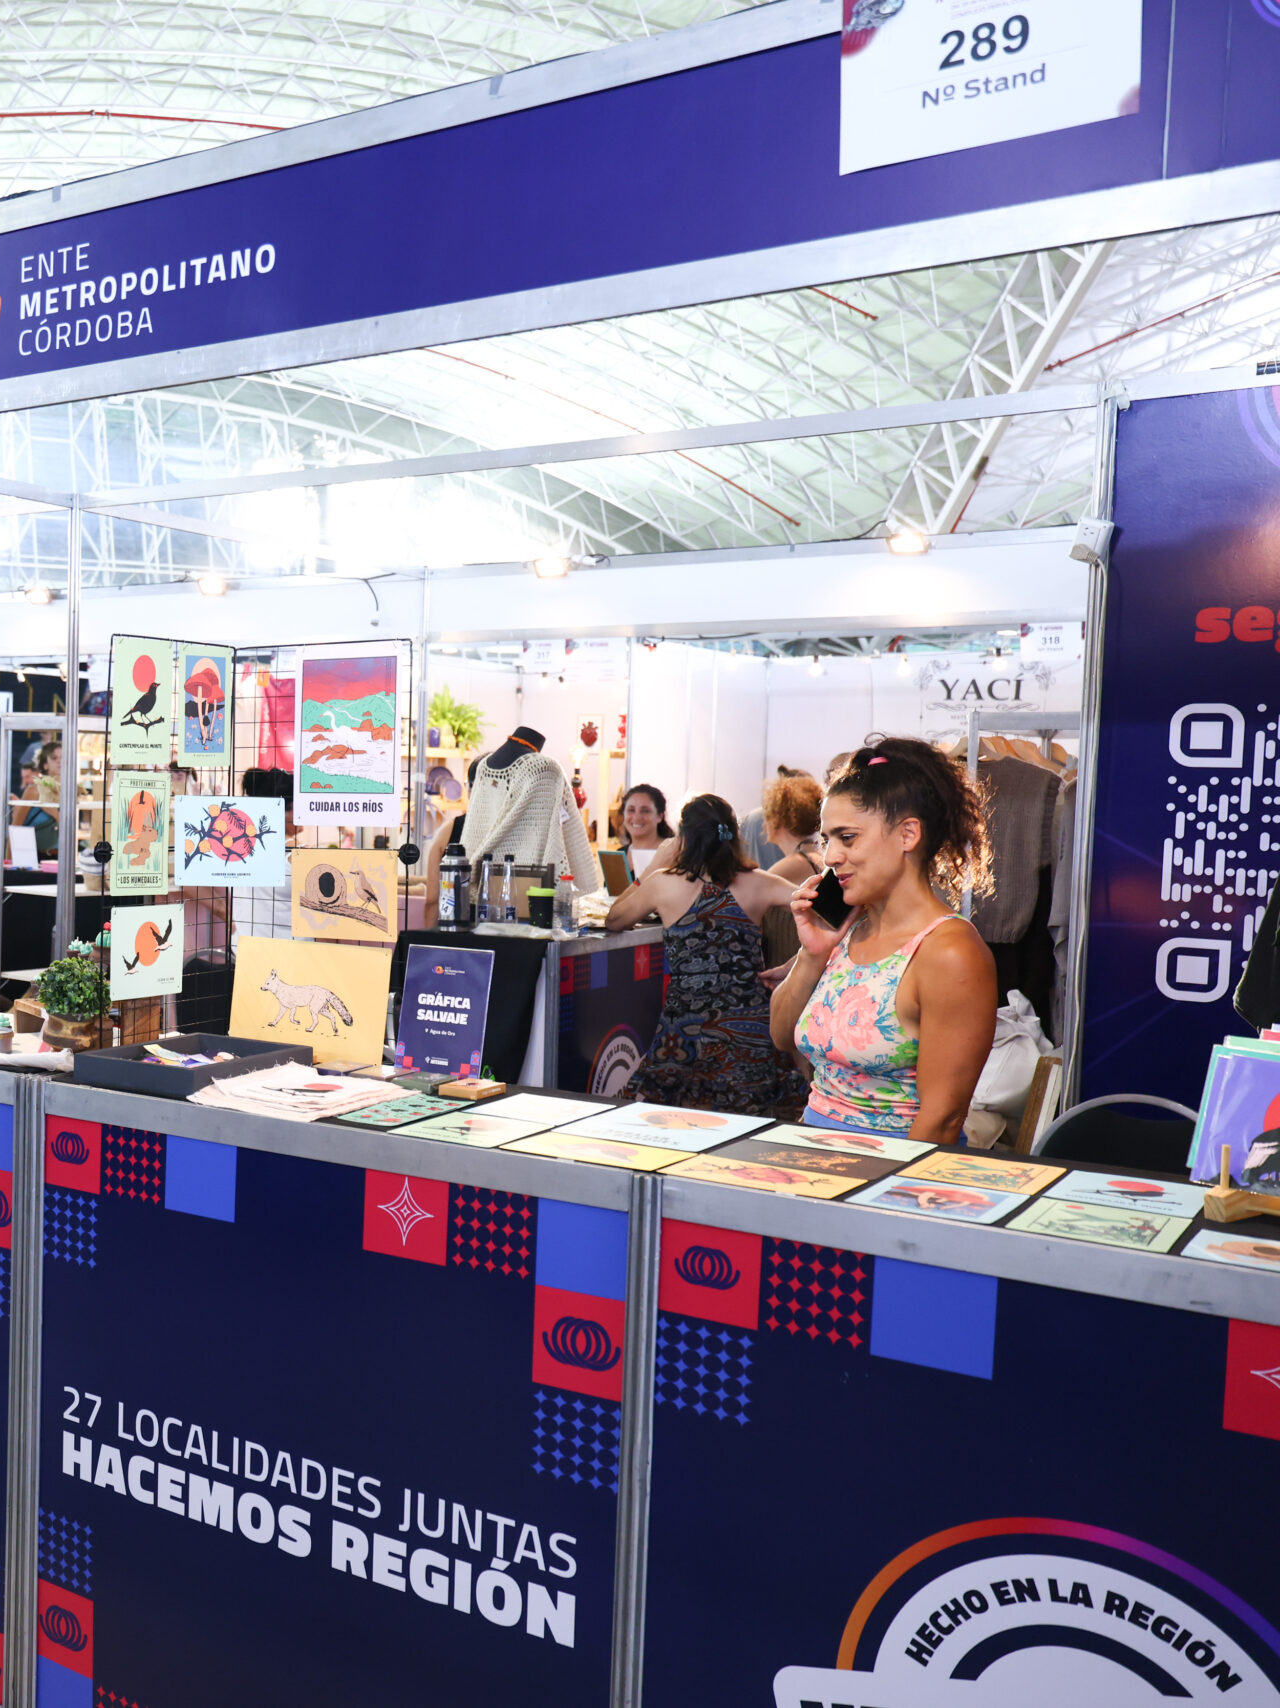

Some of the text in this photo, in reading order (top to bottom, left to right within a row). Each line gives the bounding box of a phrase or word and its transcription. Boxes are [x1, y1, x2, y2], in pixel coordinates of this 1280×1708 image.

[938, 14, 1030, 71] 289
[964, 62, 1046, 100] Stand
[20, 243, 276, 319] METROPOLITANO
[21, 242, 91, 284] ENTE
[18, 307, 153, 356] CÓRDOBA
[1041, 636, 1060, 645] 318
[1194, 605, 1280, 653] se
[938, 672, 1025, 701] YACÍ
[309, 799, 383, 813] CUIDAR LOS RÍOS
[120, 875, 159, 884] LOS HUMEDALES
[416, 1008, 468, 1025] SALVAJE
[417, 991, 471, 1010] GRÁFICA
[430, 1028, 441, 1036] Agua
[595, 1061, 608, 1093] HECHO
[62, 1386, 578, 1579] 27 LOCALIDADES JUNTAS
[62, 1429, 576, 1649] HACEMOS REGIÓN
[904, 1577, 1242, 1694] HECHO EN LA REGIÓN
